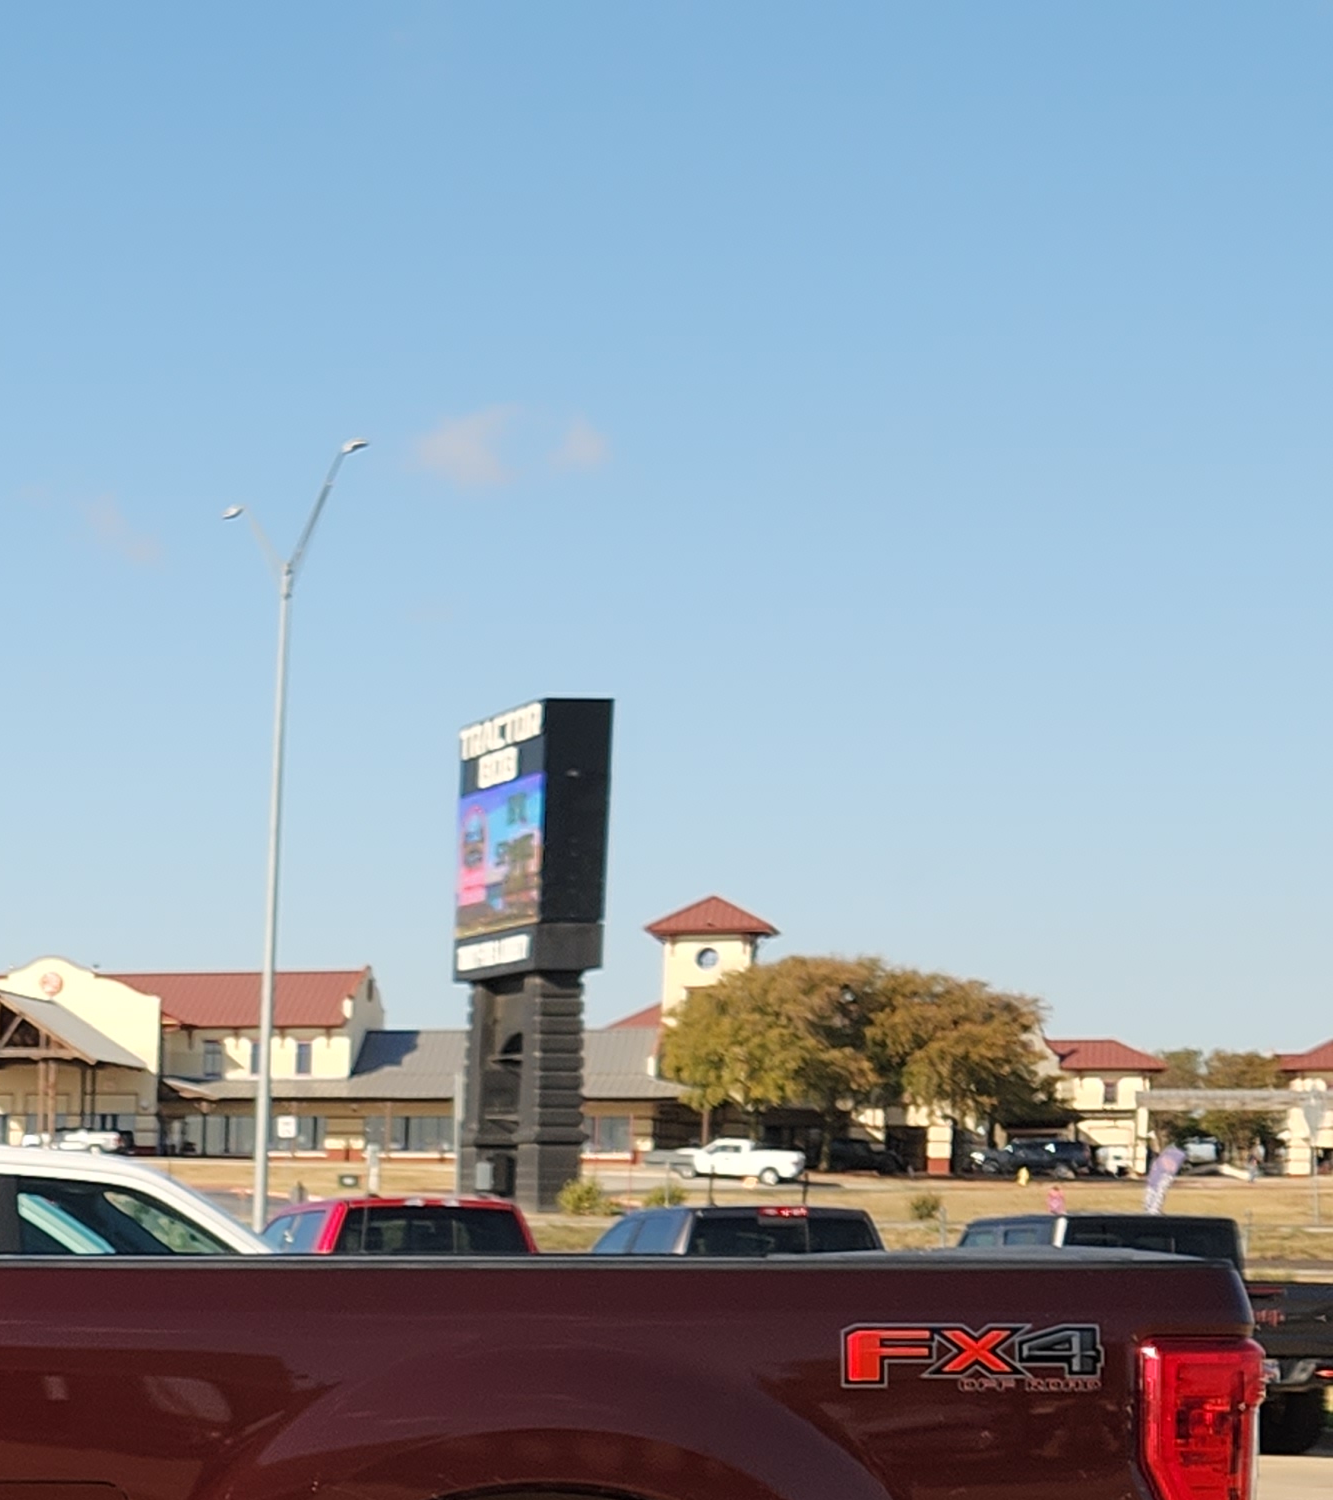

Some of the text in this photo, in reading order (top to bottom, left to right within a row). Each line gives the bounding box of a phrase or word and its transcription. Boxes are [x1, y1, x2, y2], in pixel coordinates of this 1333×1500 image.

[841, 1323, 1104, 1388] FX4
[958, 1378, 1102, 1391] OFF ROAD
